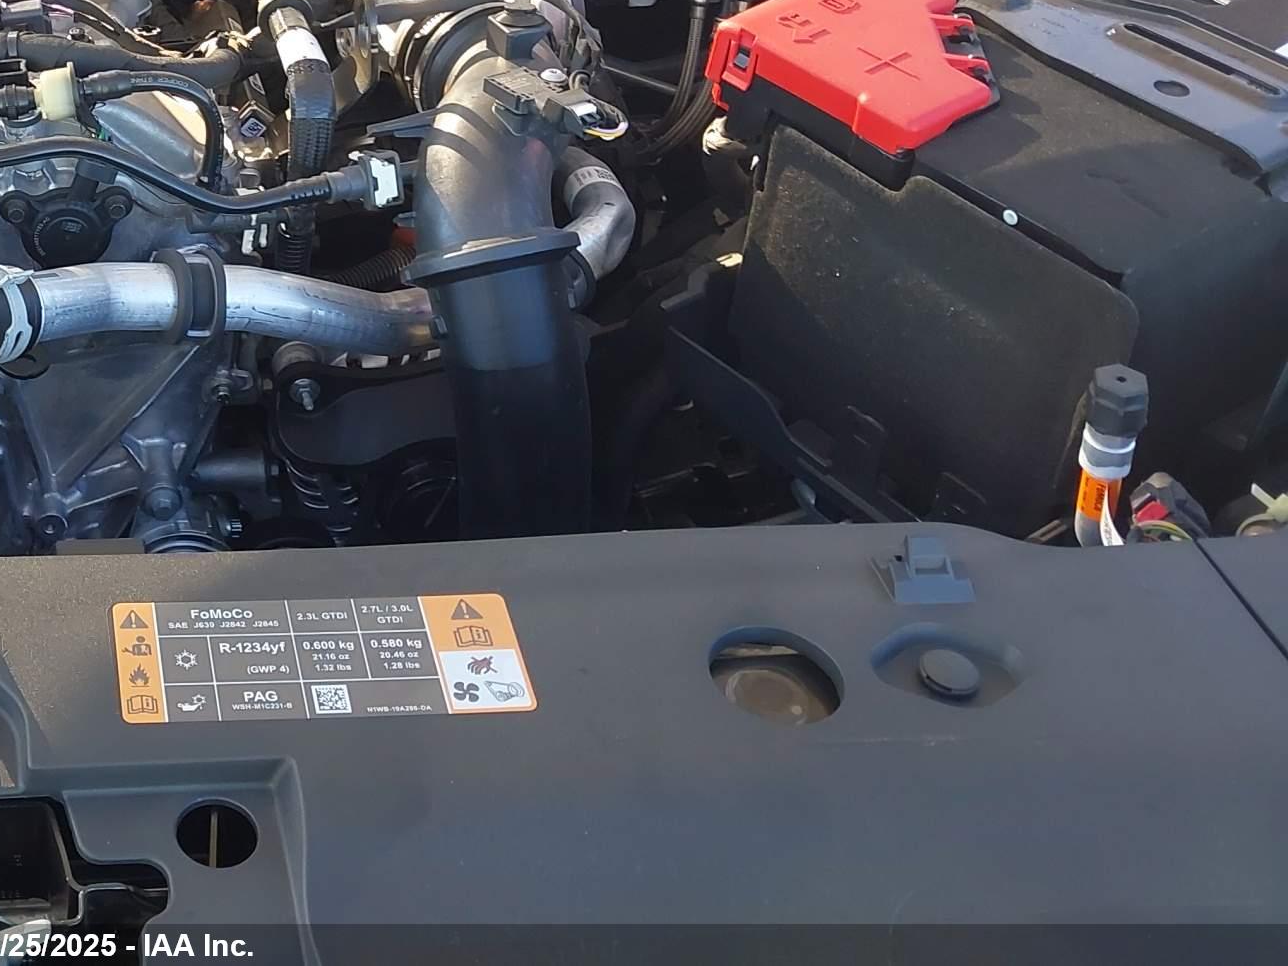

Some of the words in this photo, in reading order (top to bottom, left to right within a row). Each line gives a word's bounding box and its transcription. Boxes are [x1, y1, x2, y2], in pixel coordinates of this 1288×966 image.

[361, 605, 383, 614] 2.7L
[391, 604, 413, 612] 3.0L
[190, 609, 253, 619] FoMoCo
[297, 613, 319, 621] 2.3L
[321, 612, 348, 620] GTDI
[377, 615, 403, 624] GTDI
[218, 641, 285, 654] R-1234yf
[302, 641, 335, 650] 0.600
[338, 640, 354, 650] kg
[370, 639, 404, 648] 0.580
[406, 638, 422, 649] kg
[312, 653, 336, 661] 21.16
[247, 665, 277, 674] (GWP
[279, 665, 290, 674] 4)
[336, 663, 352, 671] lbs
[383, 662, 403, 670] 1.28
[405, 661, 421, 669] lbs
[243, 691, 278, 702] PAG
